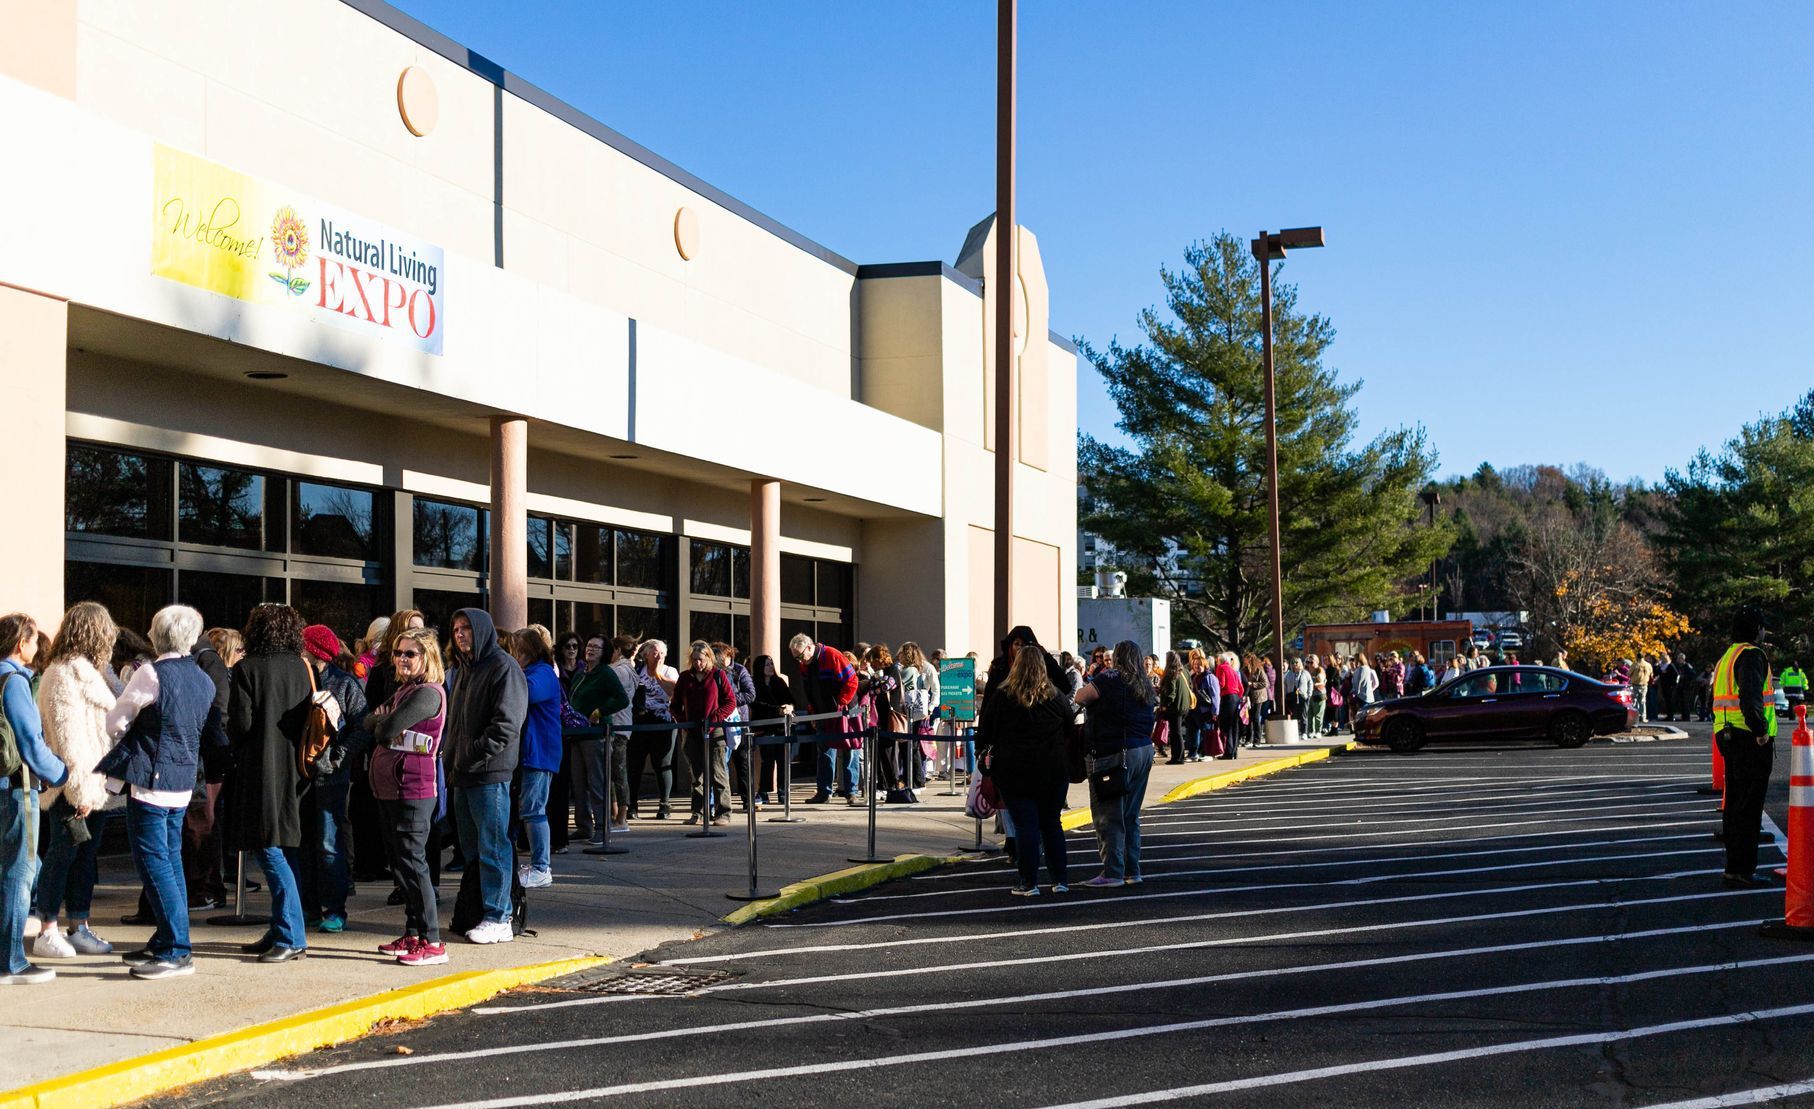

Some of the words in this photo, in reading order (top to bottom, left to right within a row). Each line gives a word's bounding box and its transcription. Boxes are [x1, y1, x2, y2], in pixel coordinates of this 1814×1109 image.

[163, 197, 264, 260] Welcome!
[321, 218, 385, 270] Natural
[389, 243, 437, 296] Living
[315, 255, 436, 339] EXPO
